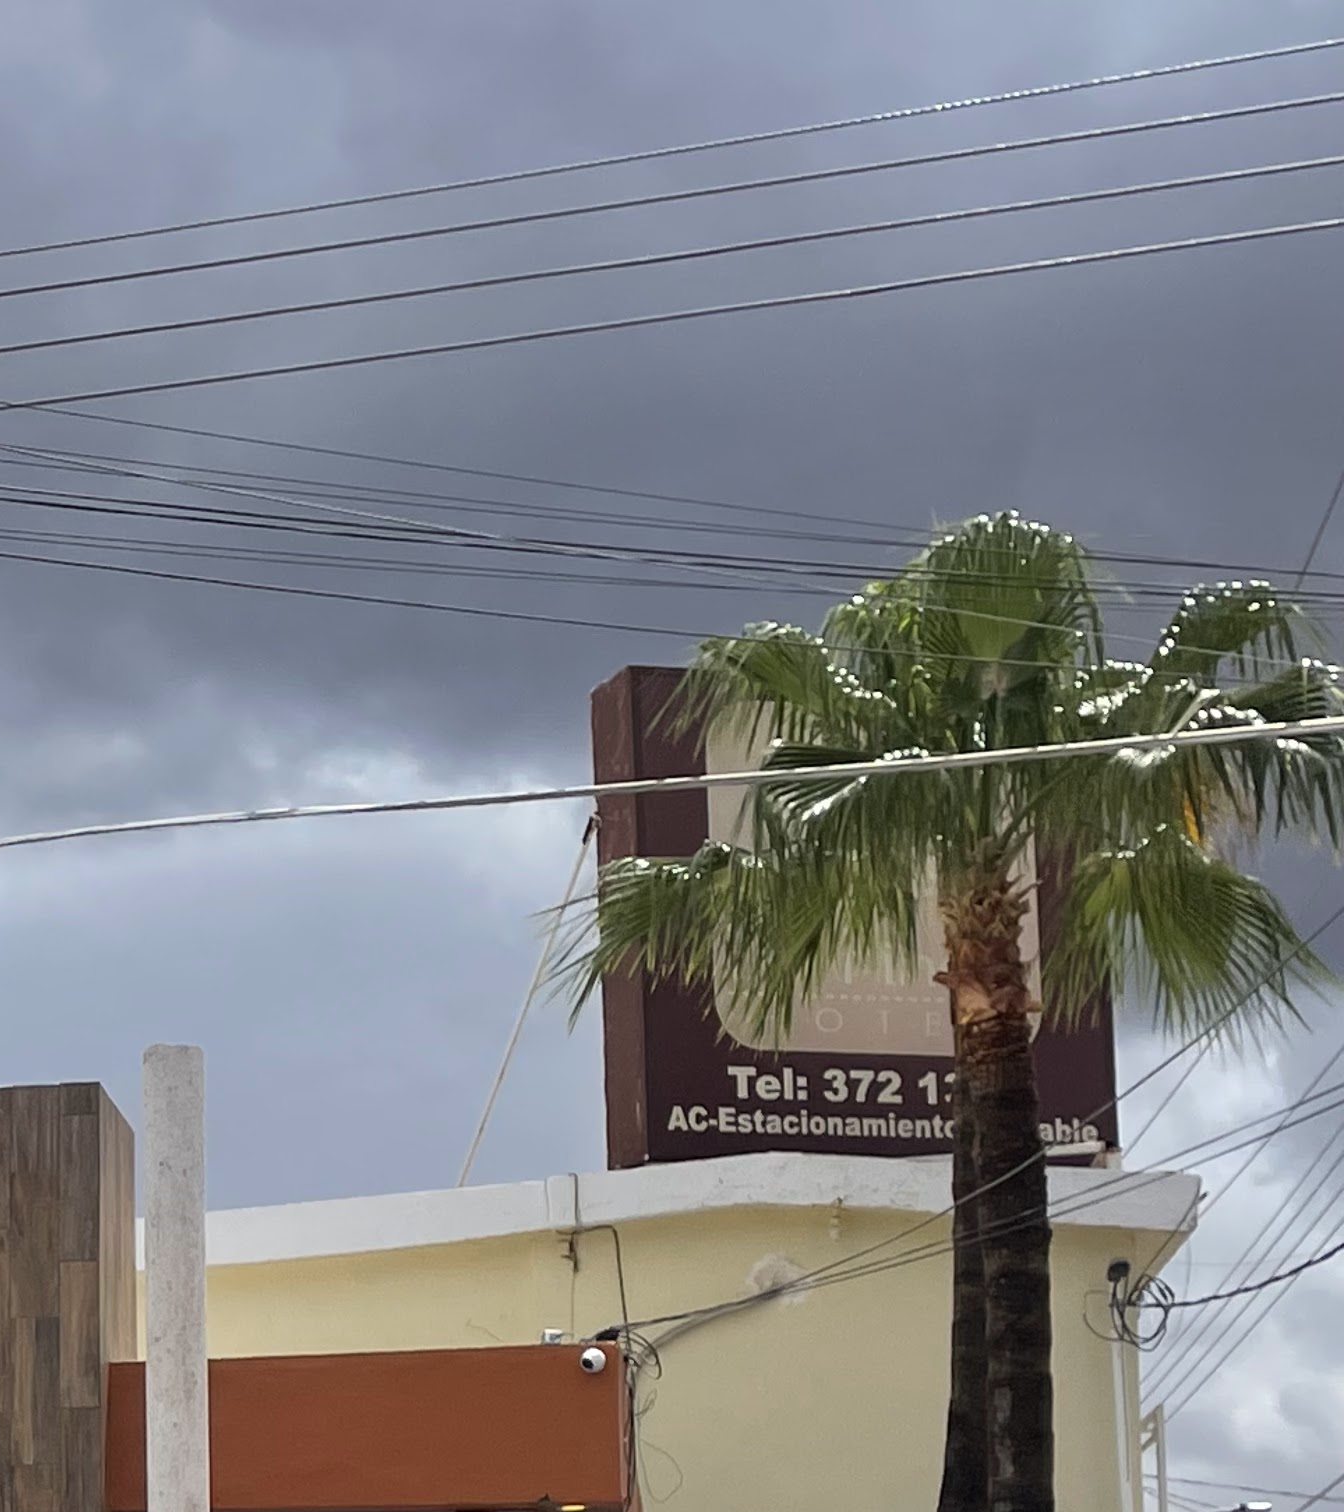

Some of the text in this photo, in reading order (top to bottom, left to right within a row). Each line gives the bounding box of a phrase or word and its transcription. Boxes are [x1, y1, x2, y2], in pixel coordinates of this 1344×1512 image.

[727, 1065, 808, 1100] Tel:
[823, 1068, 903, 1104] 372
[1039, 1117, 1099, 1142] able
